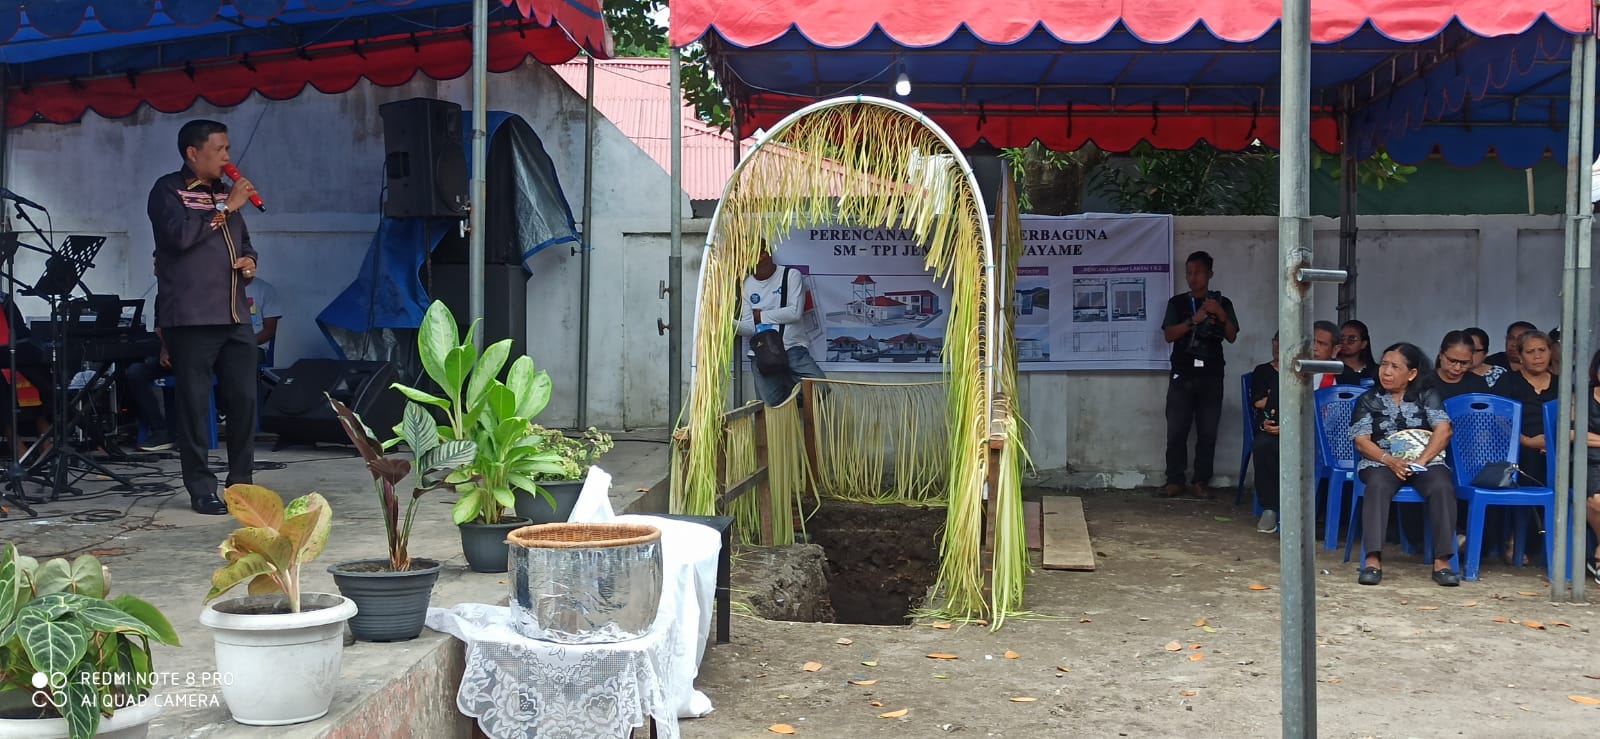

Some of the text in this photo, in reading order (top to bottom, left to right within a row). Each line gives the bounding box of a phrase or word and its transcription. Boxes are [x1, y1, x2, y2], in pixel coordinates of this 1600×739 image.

[809, 229, 1108, 241] PERENCANA ERBAGUNA
[833, 244, 856, 256] SM
[872, 244, 898, 256] TPI
